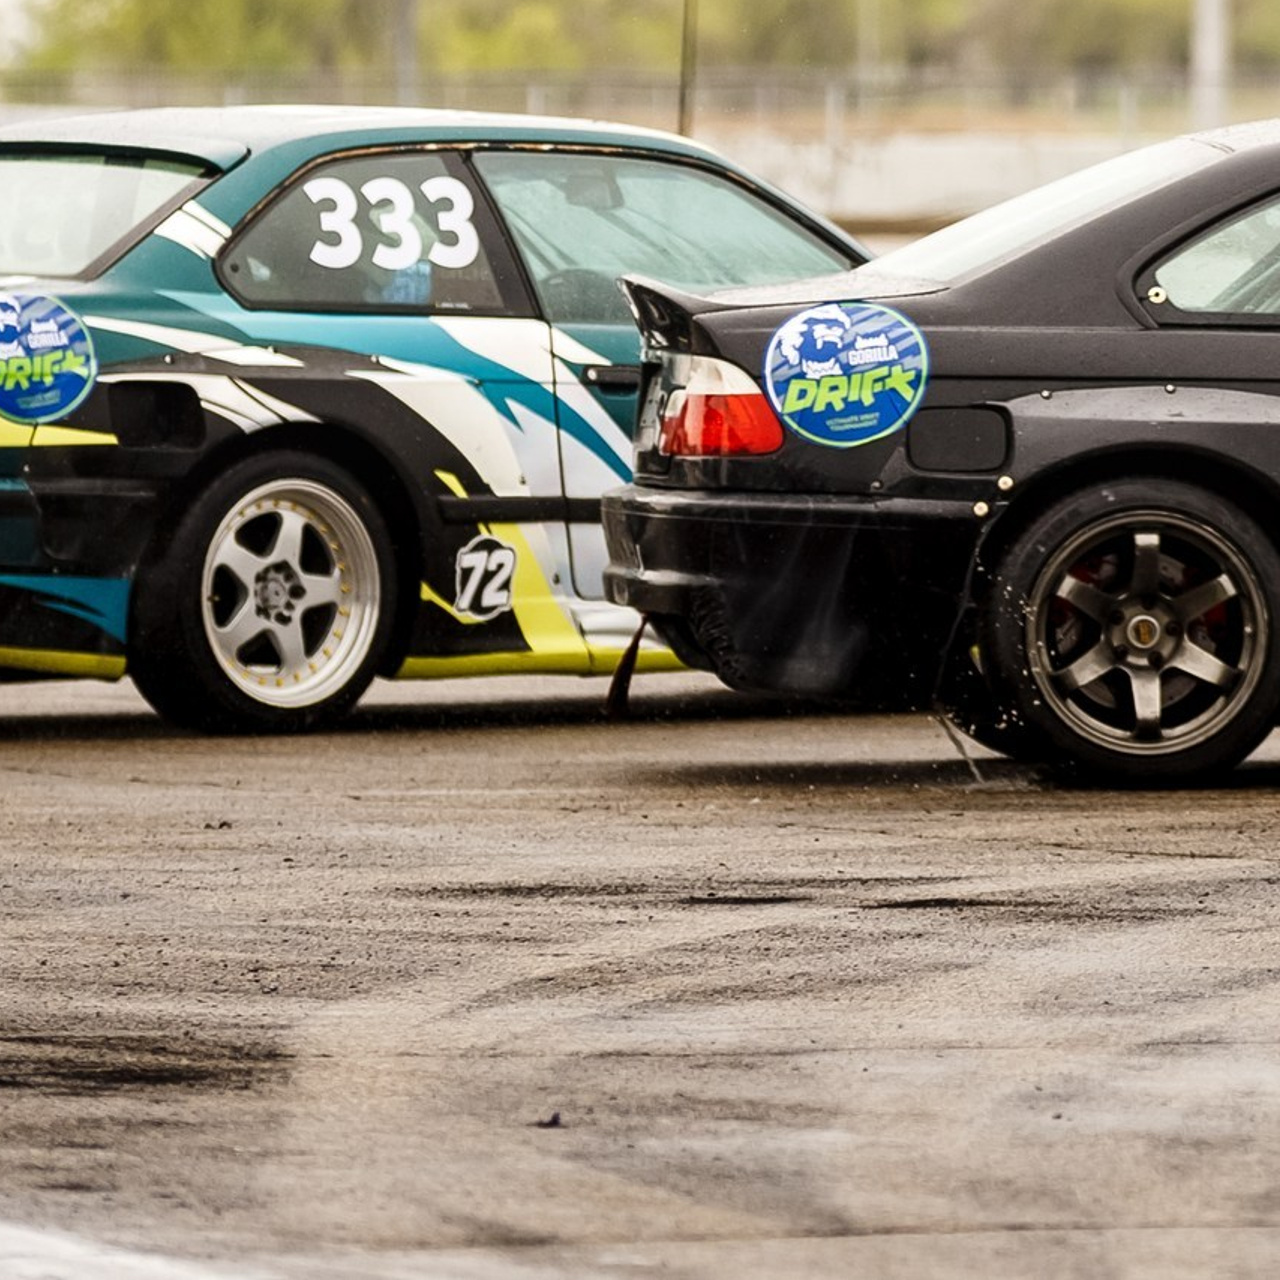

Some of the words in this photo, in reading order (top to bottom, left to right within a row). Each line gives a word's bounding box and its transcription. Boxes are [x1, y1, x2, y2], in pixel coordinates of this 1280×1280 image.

[303, 176, 479, 269] 333
[0, 349, 89, 391] RIFT
[848, 345, 898, 366] GORILLA
[457, 549, 515, 610] 72
